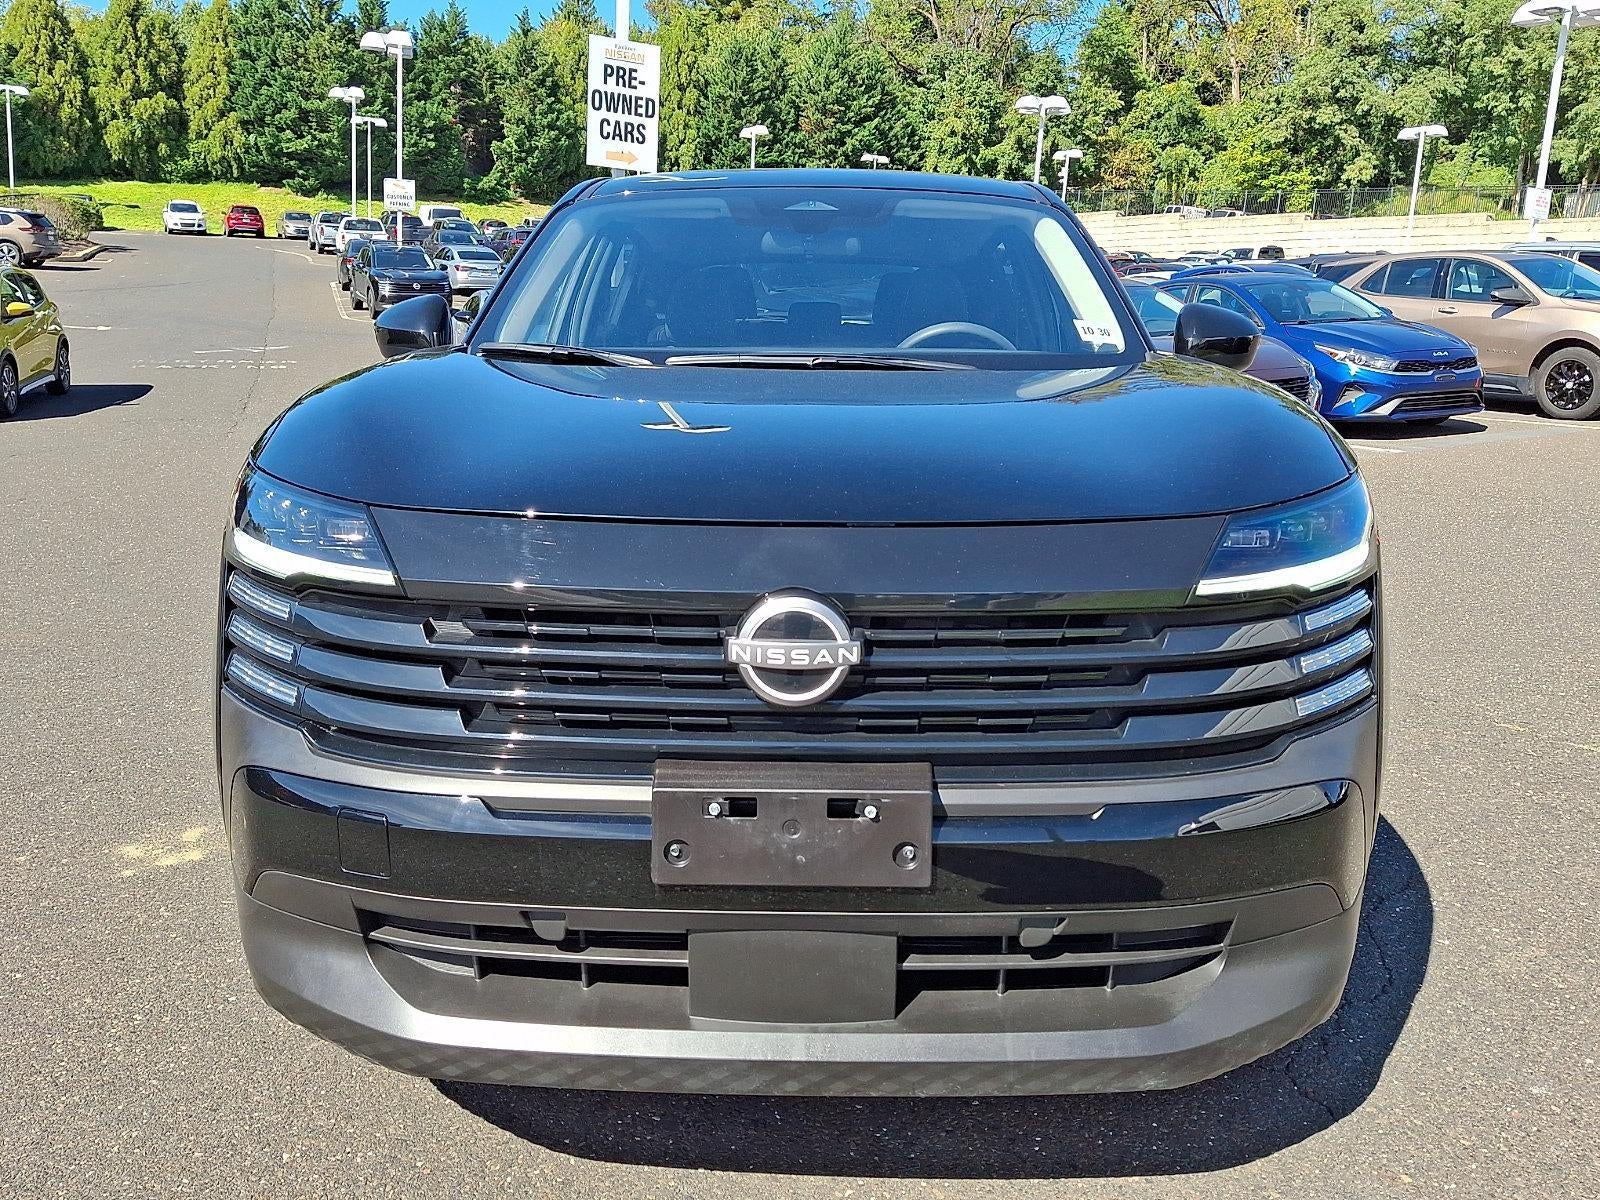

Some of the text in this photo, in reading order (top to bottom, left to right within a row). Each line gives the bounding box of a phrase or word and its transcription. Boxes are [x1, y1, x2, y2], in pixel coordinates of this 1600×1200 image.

[605, 48, 645, 63] NISSAN
[603, 63, 646, 90] PRE-
[591, 88, 656, 119] OWNED
[599, 117, 647, 145] CARS
[1081, 326, 1111, 337] 10 30
[731, 644, 858, 666] NISSAN
